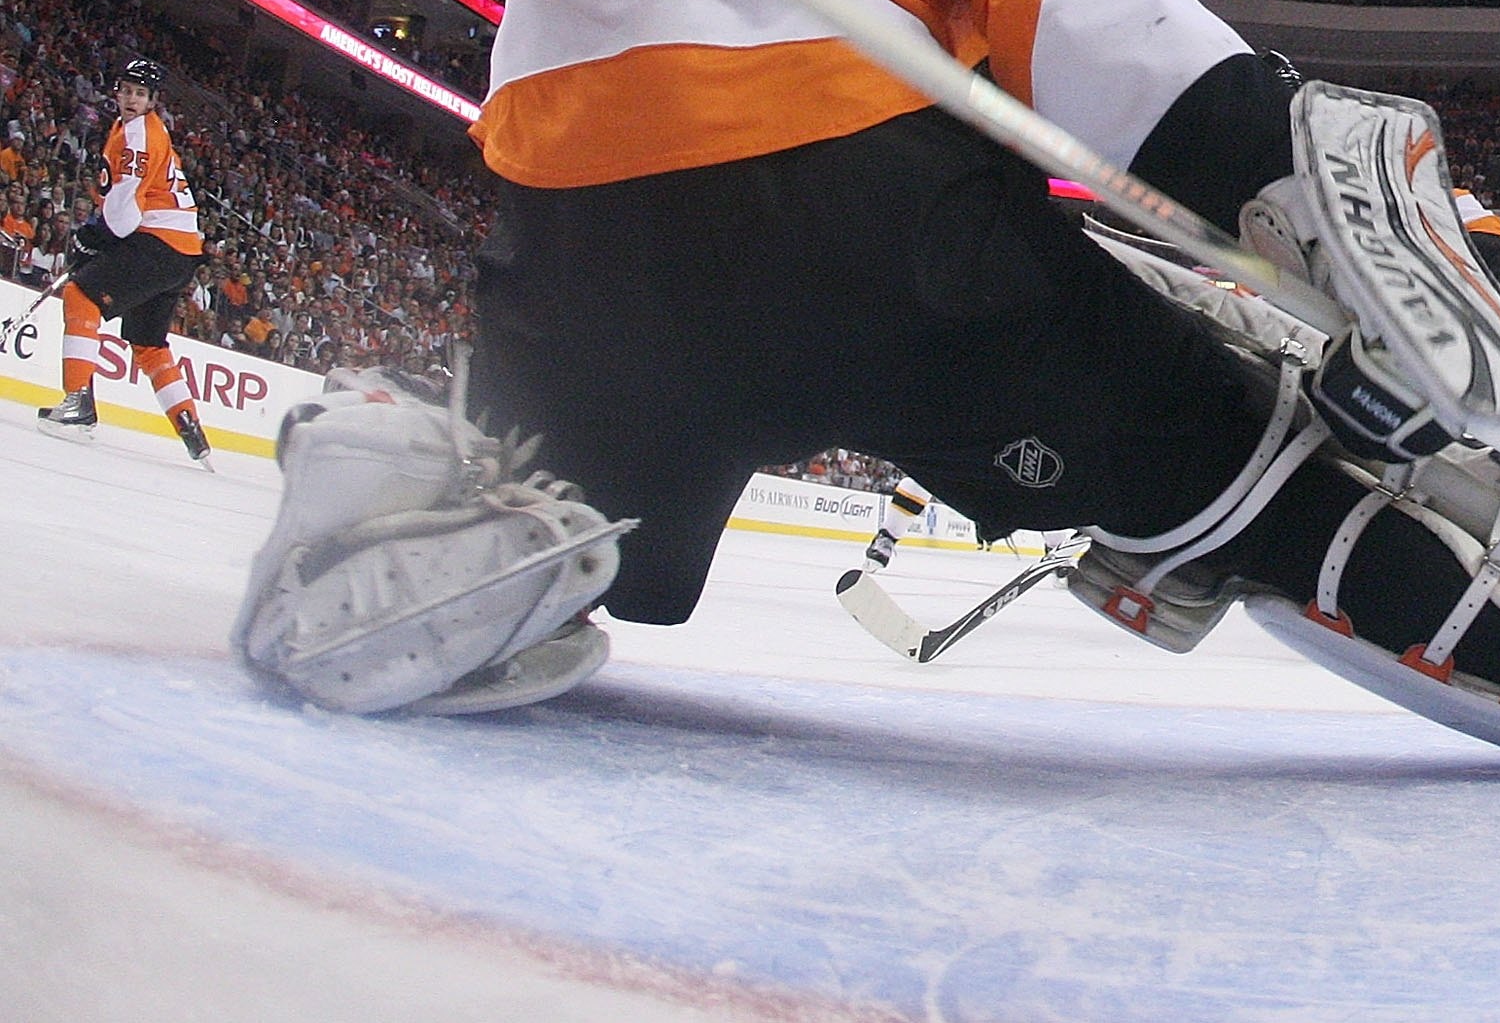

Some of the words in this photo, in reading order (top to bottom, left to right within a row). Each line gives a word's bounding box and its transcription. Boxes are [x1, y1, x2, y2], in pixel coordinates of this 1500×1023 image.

[320, 24, 382, 70] AMERICA'S
[382, 58, 413, 86] MOST
[413, 75, 461, 115] RELIABLE
[119, 147, 151, 179] 25
[1022, 448, 1040, 481] NHL
[769, 490, 809, 509] AIRWAYS
[814, 496, 839, 514] BUD
[841, 501, 873, 519] LIGHT
